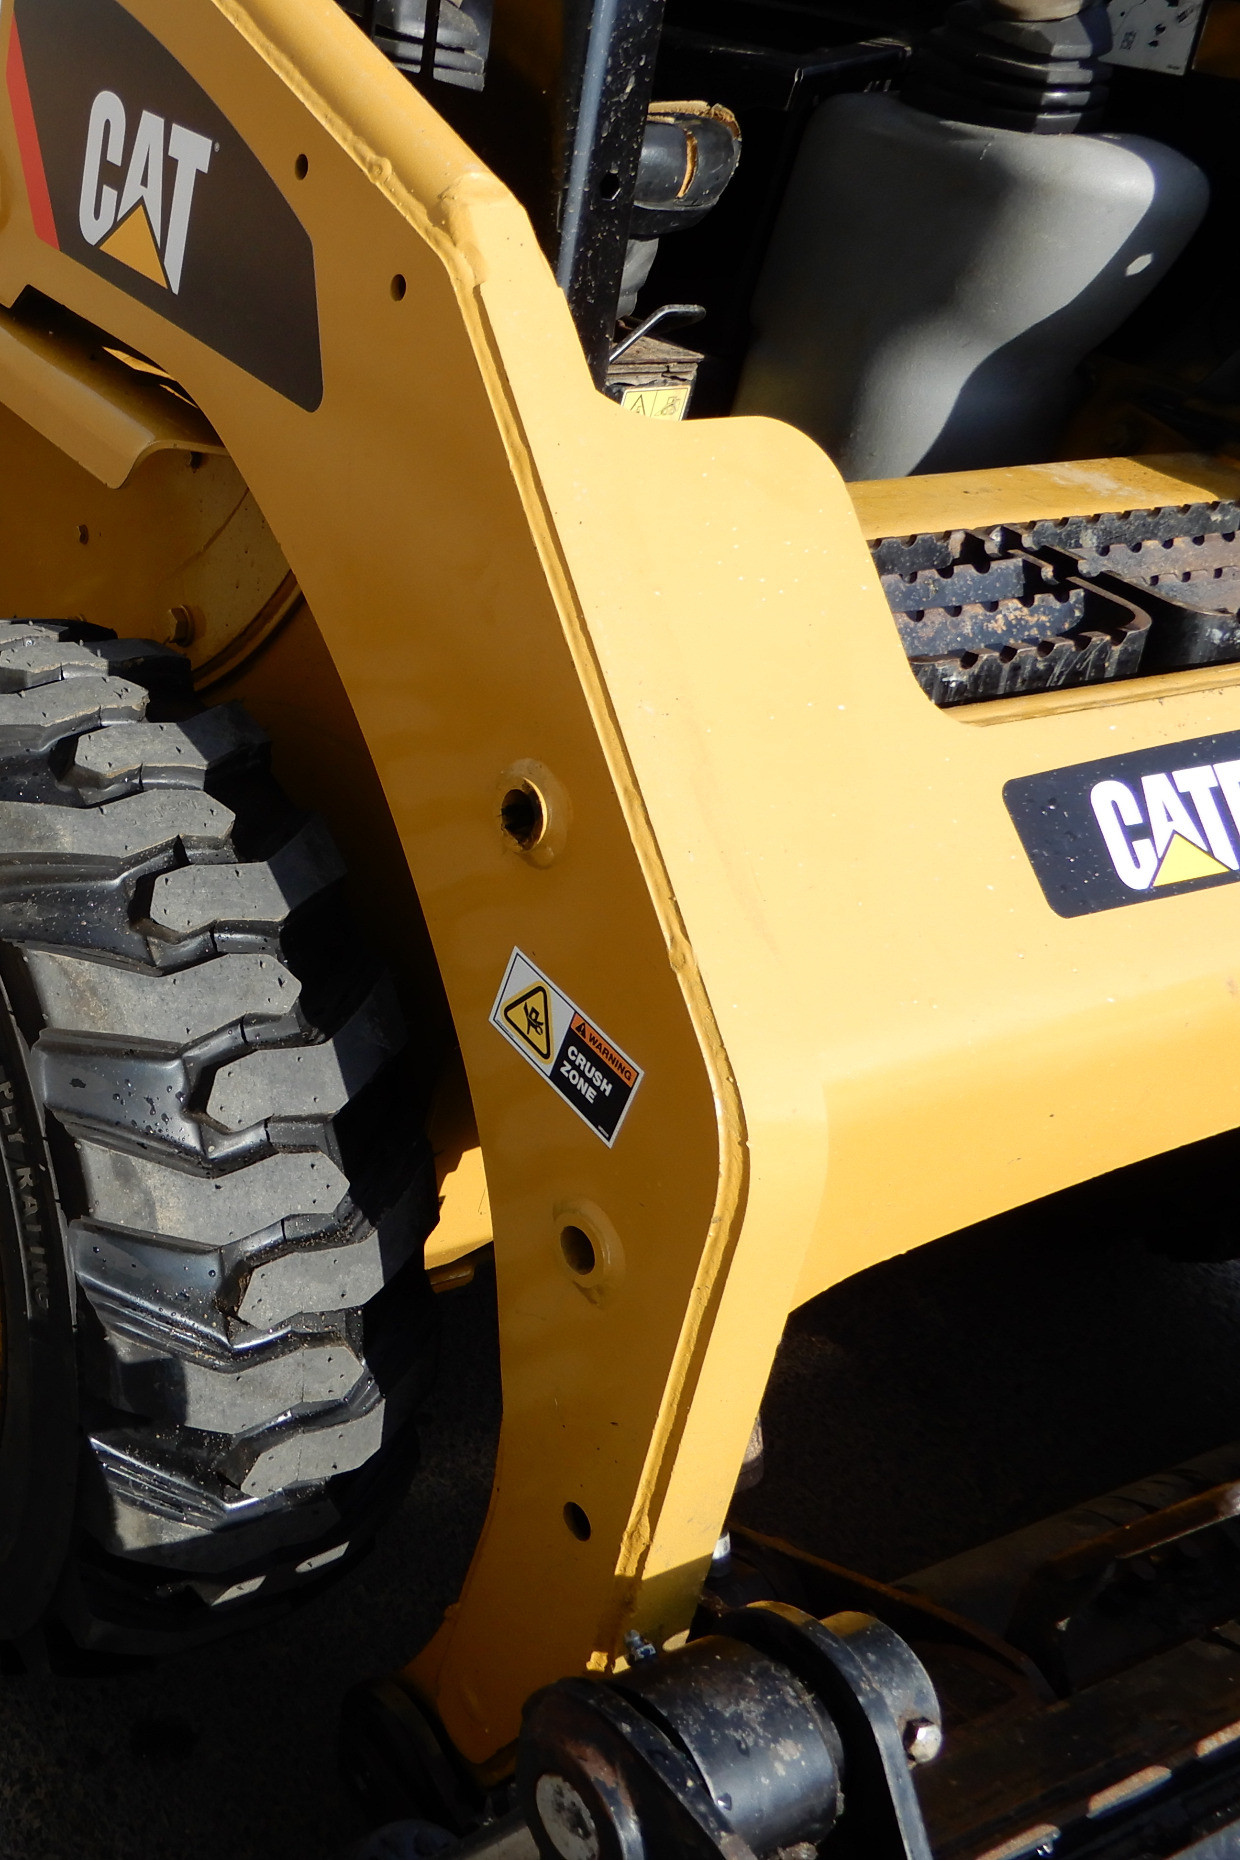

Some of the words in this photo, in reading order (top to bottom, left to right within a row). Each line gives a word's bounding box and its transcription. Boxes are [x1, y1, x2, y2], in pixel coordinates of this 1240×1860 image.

[79, 90, 213, 296] CAT
[559, 1060, 598, 1105] ZONE
[567, 1045, 613, 1098] CRUSH
[588, 1032, 633, 1082] WARNING
